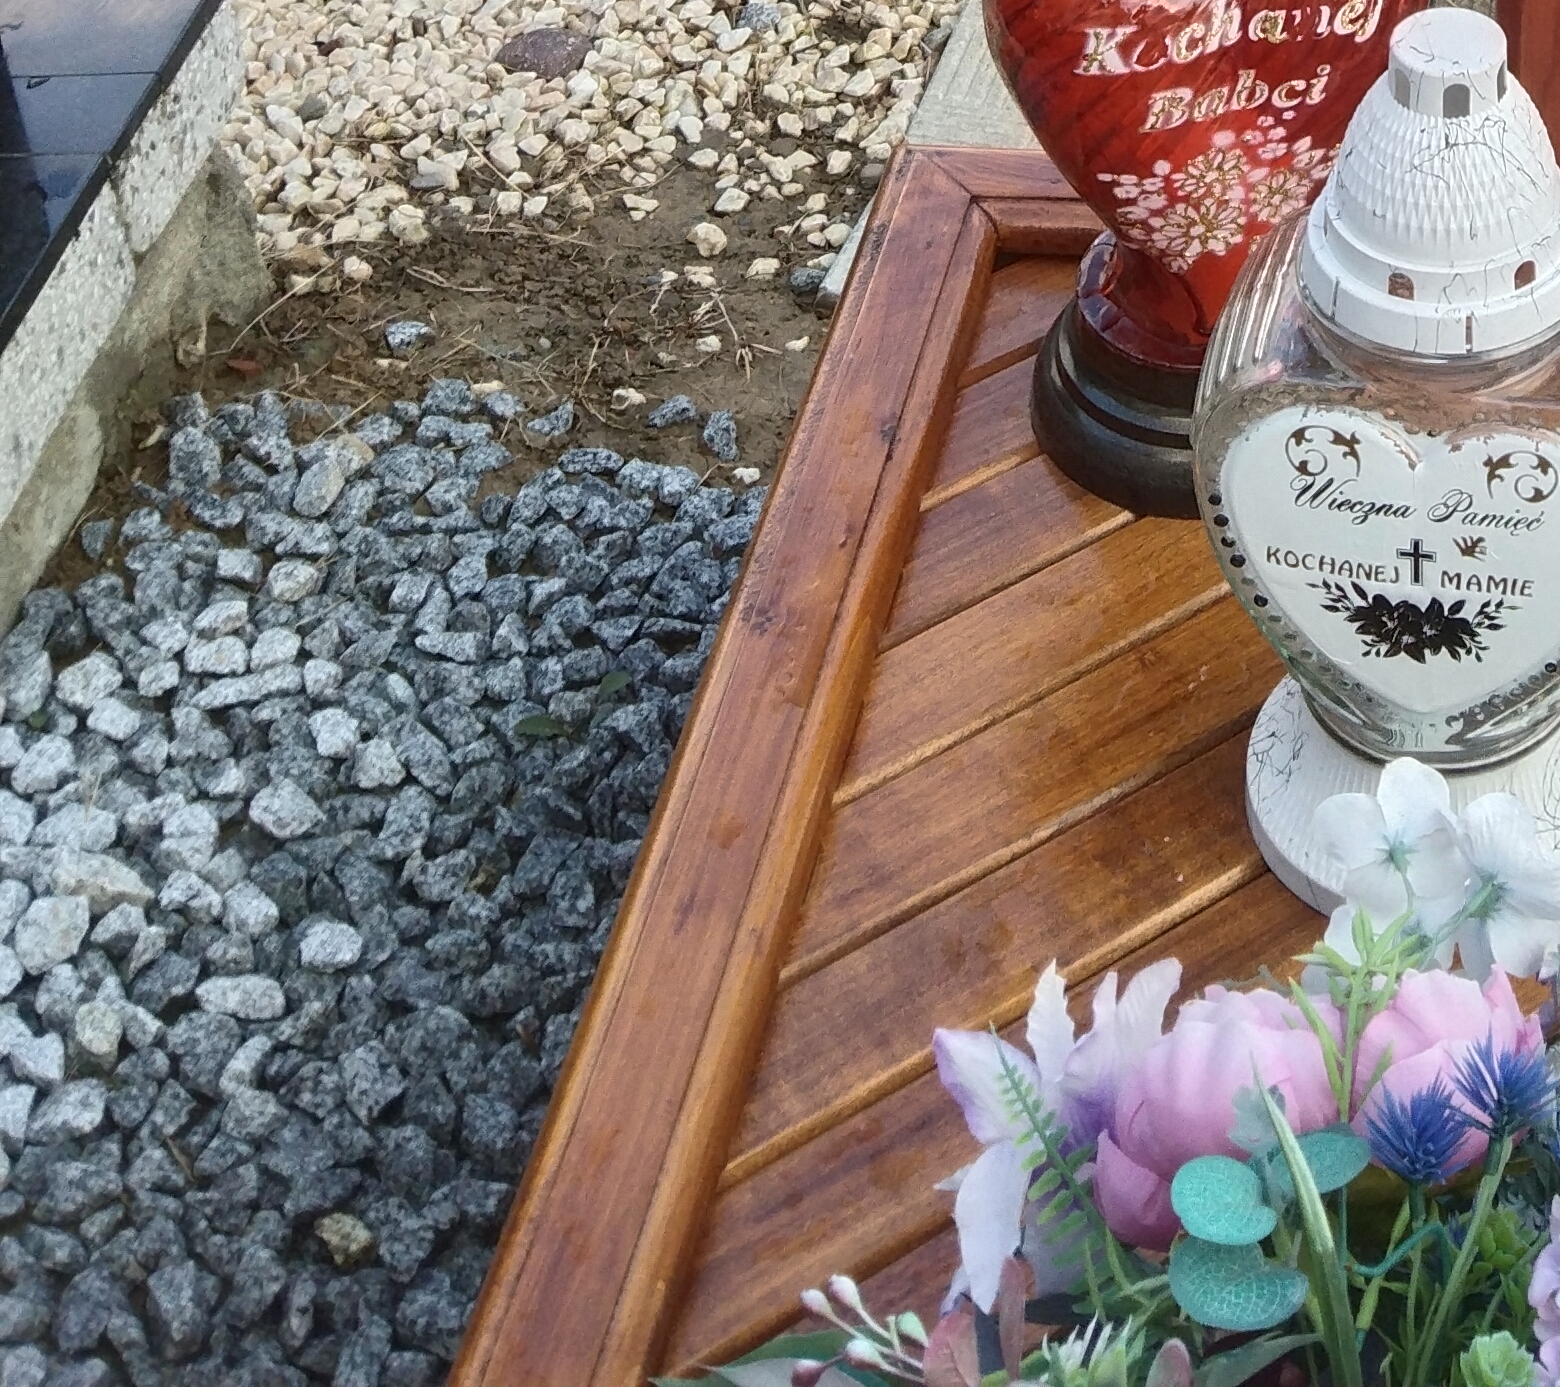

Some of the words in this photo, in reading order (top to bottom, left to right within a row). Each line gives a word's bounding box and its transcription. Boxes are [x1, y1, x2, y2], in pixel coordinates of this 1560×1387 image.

[1139, 64, 1332, 134] Babci
[1289, 476, 1416, 525] Wieczna
[1427, 488, 1546, 535] Pamięć
[1265, 545, 1400, 584] KOCHANEJ
[1440, 570, 1536, 598] MAMIE
